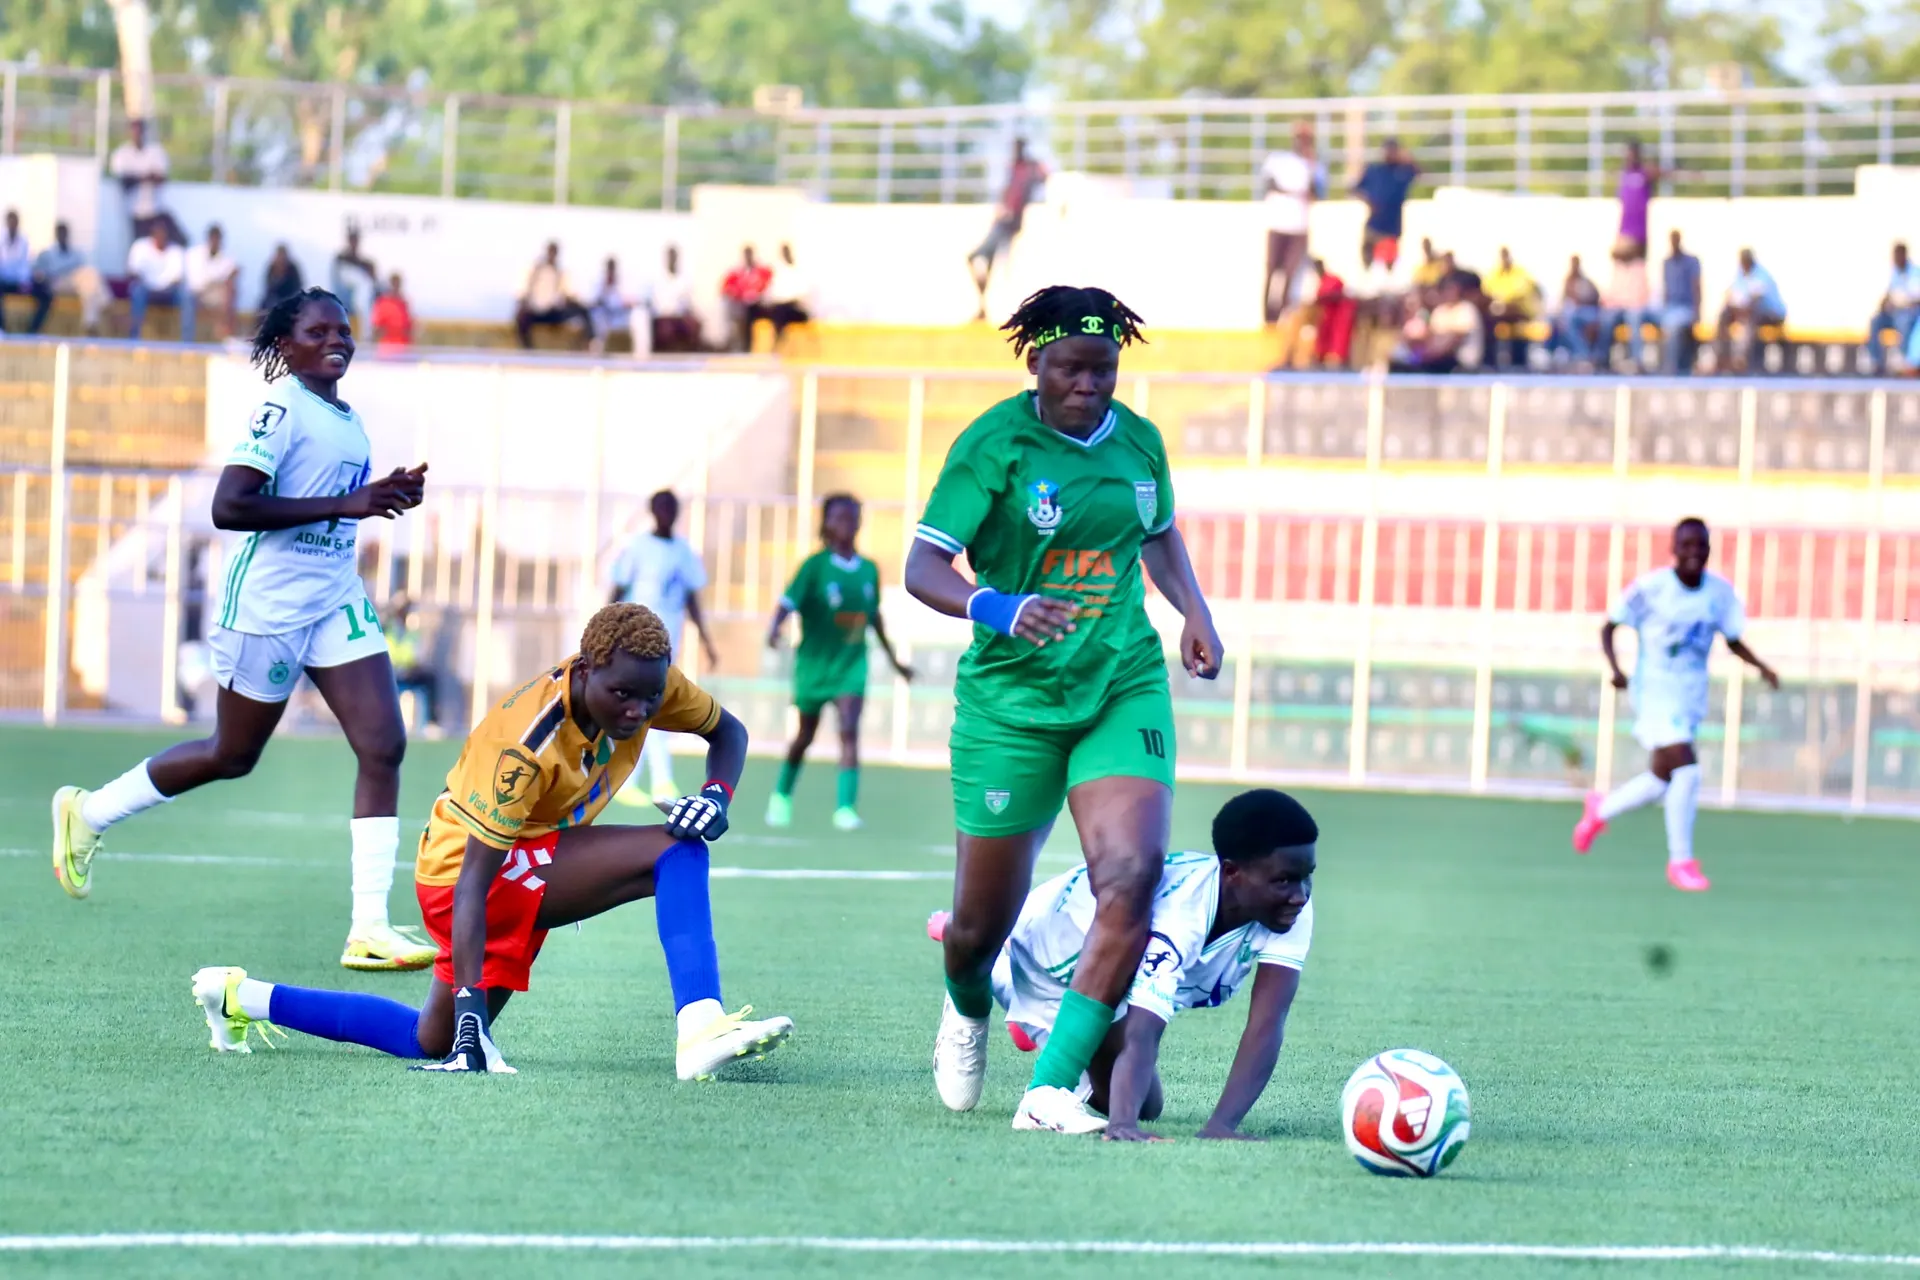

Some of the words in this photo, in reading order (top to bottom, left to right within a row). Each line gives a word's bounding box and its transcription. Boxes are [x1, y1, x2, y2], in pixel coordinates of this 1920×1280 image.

[294, 532, 331, 548] ADIM
[335, 538, 343, 550] &
[1042, 550, 1116, 577] FIFA
[339, 597, 382, 641] 14
[1137, 728, 1165, 759] 10
[468, 789, 488, 814] Visit
